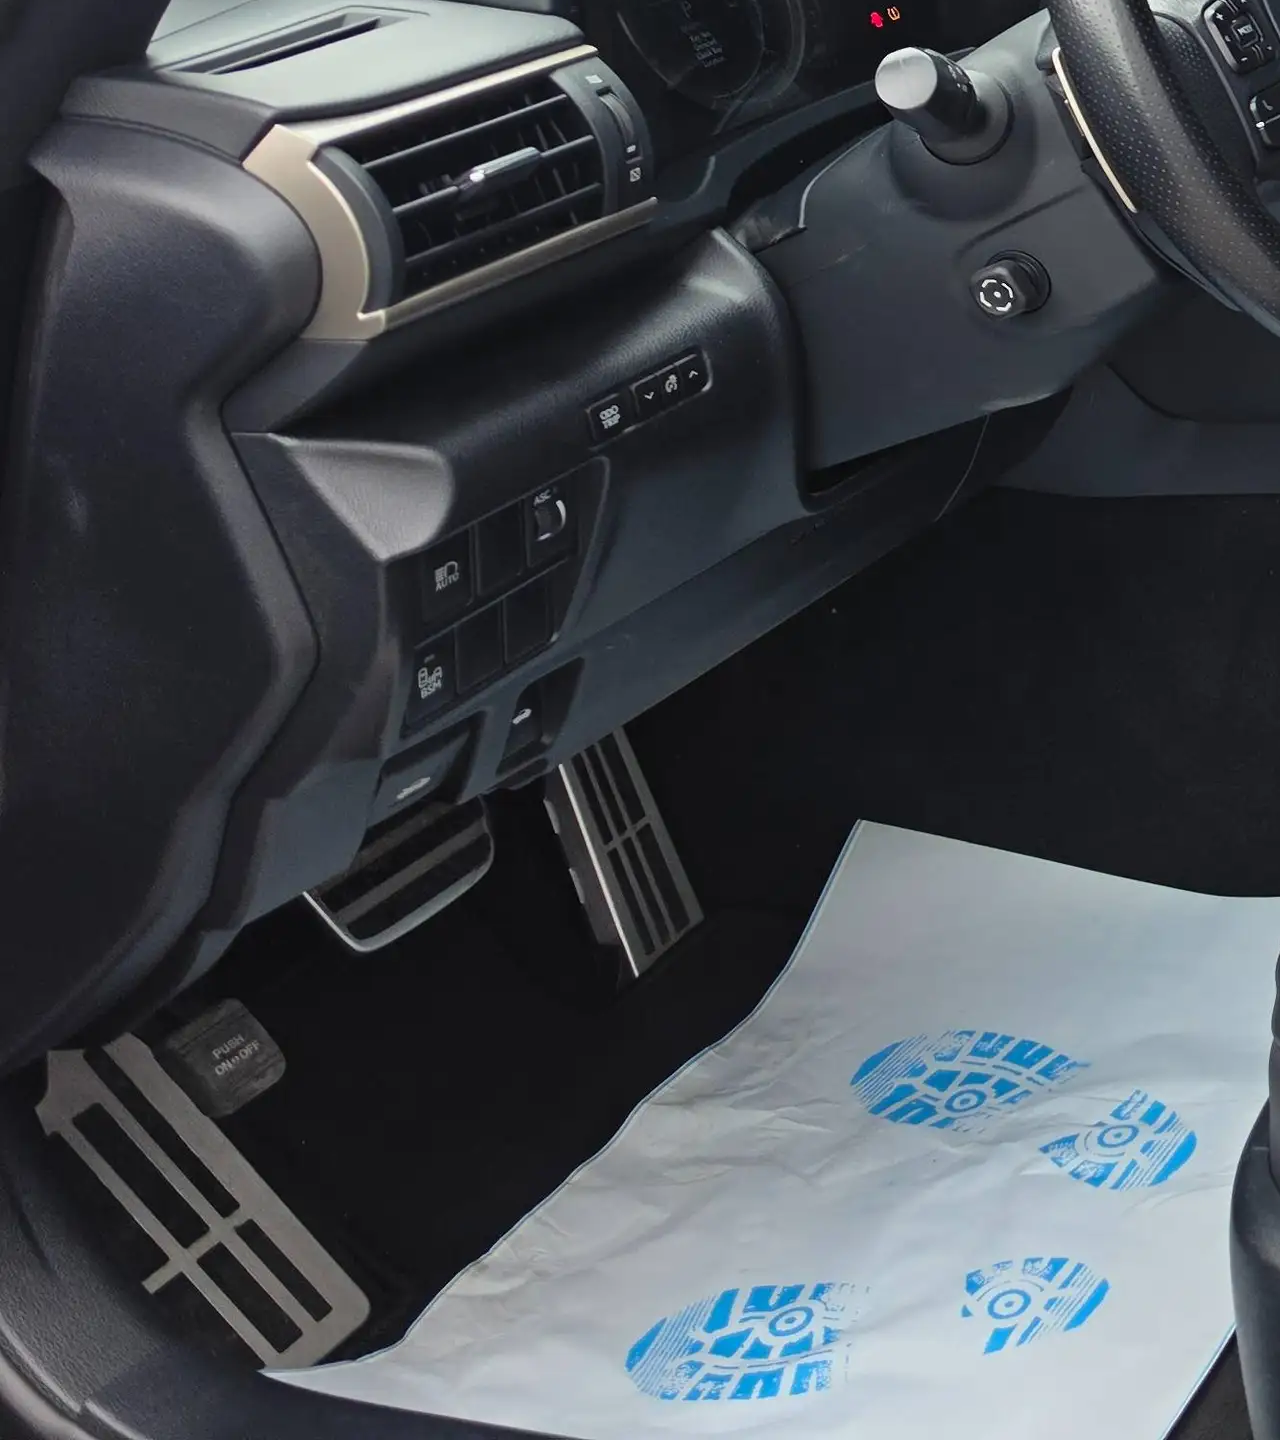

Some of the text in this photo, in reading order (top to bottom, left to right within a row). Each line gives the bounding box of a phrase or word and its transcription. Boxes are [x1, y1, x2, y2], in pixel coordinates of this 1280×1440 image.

[533, 489, 551, 506] ASC
[435, 572, 460, 592] AUTO
[420, 677, 442, 698] BSM
[212, 1033, 244, 1059] PUSH
